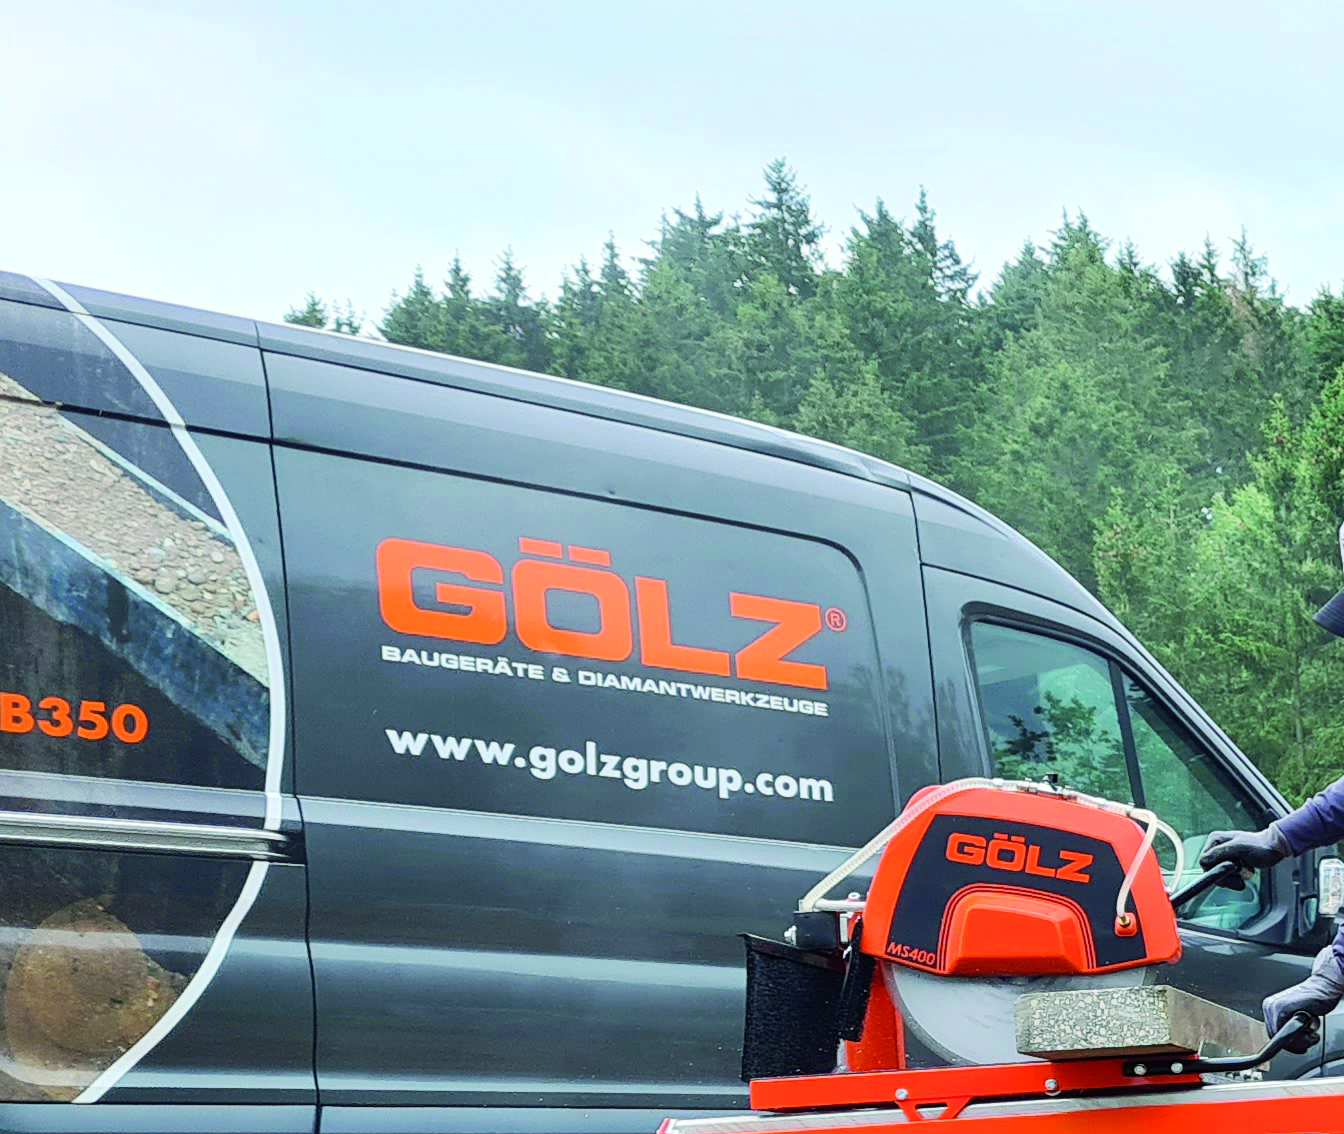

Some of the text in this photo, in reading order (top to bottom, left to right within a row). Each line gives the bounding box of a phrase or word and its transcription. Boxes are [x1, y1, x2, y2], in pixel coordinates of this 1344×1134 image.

[381, 645, 829, 717] BAUGERÄTE & DIAMANTWERKZEUGE
[0, 691, 149, 744] B350
[384, 728, 834, 802] www.golzgroup.com
[946, 832, 1094, 883] GÖLZ
[887, 942, 936, 966] MS400
